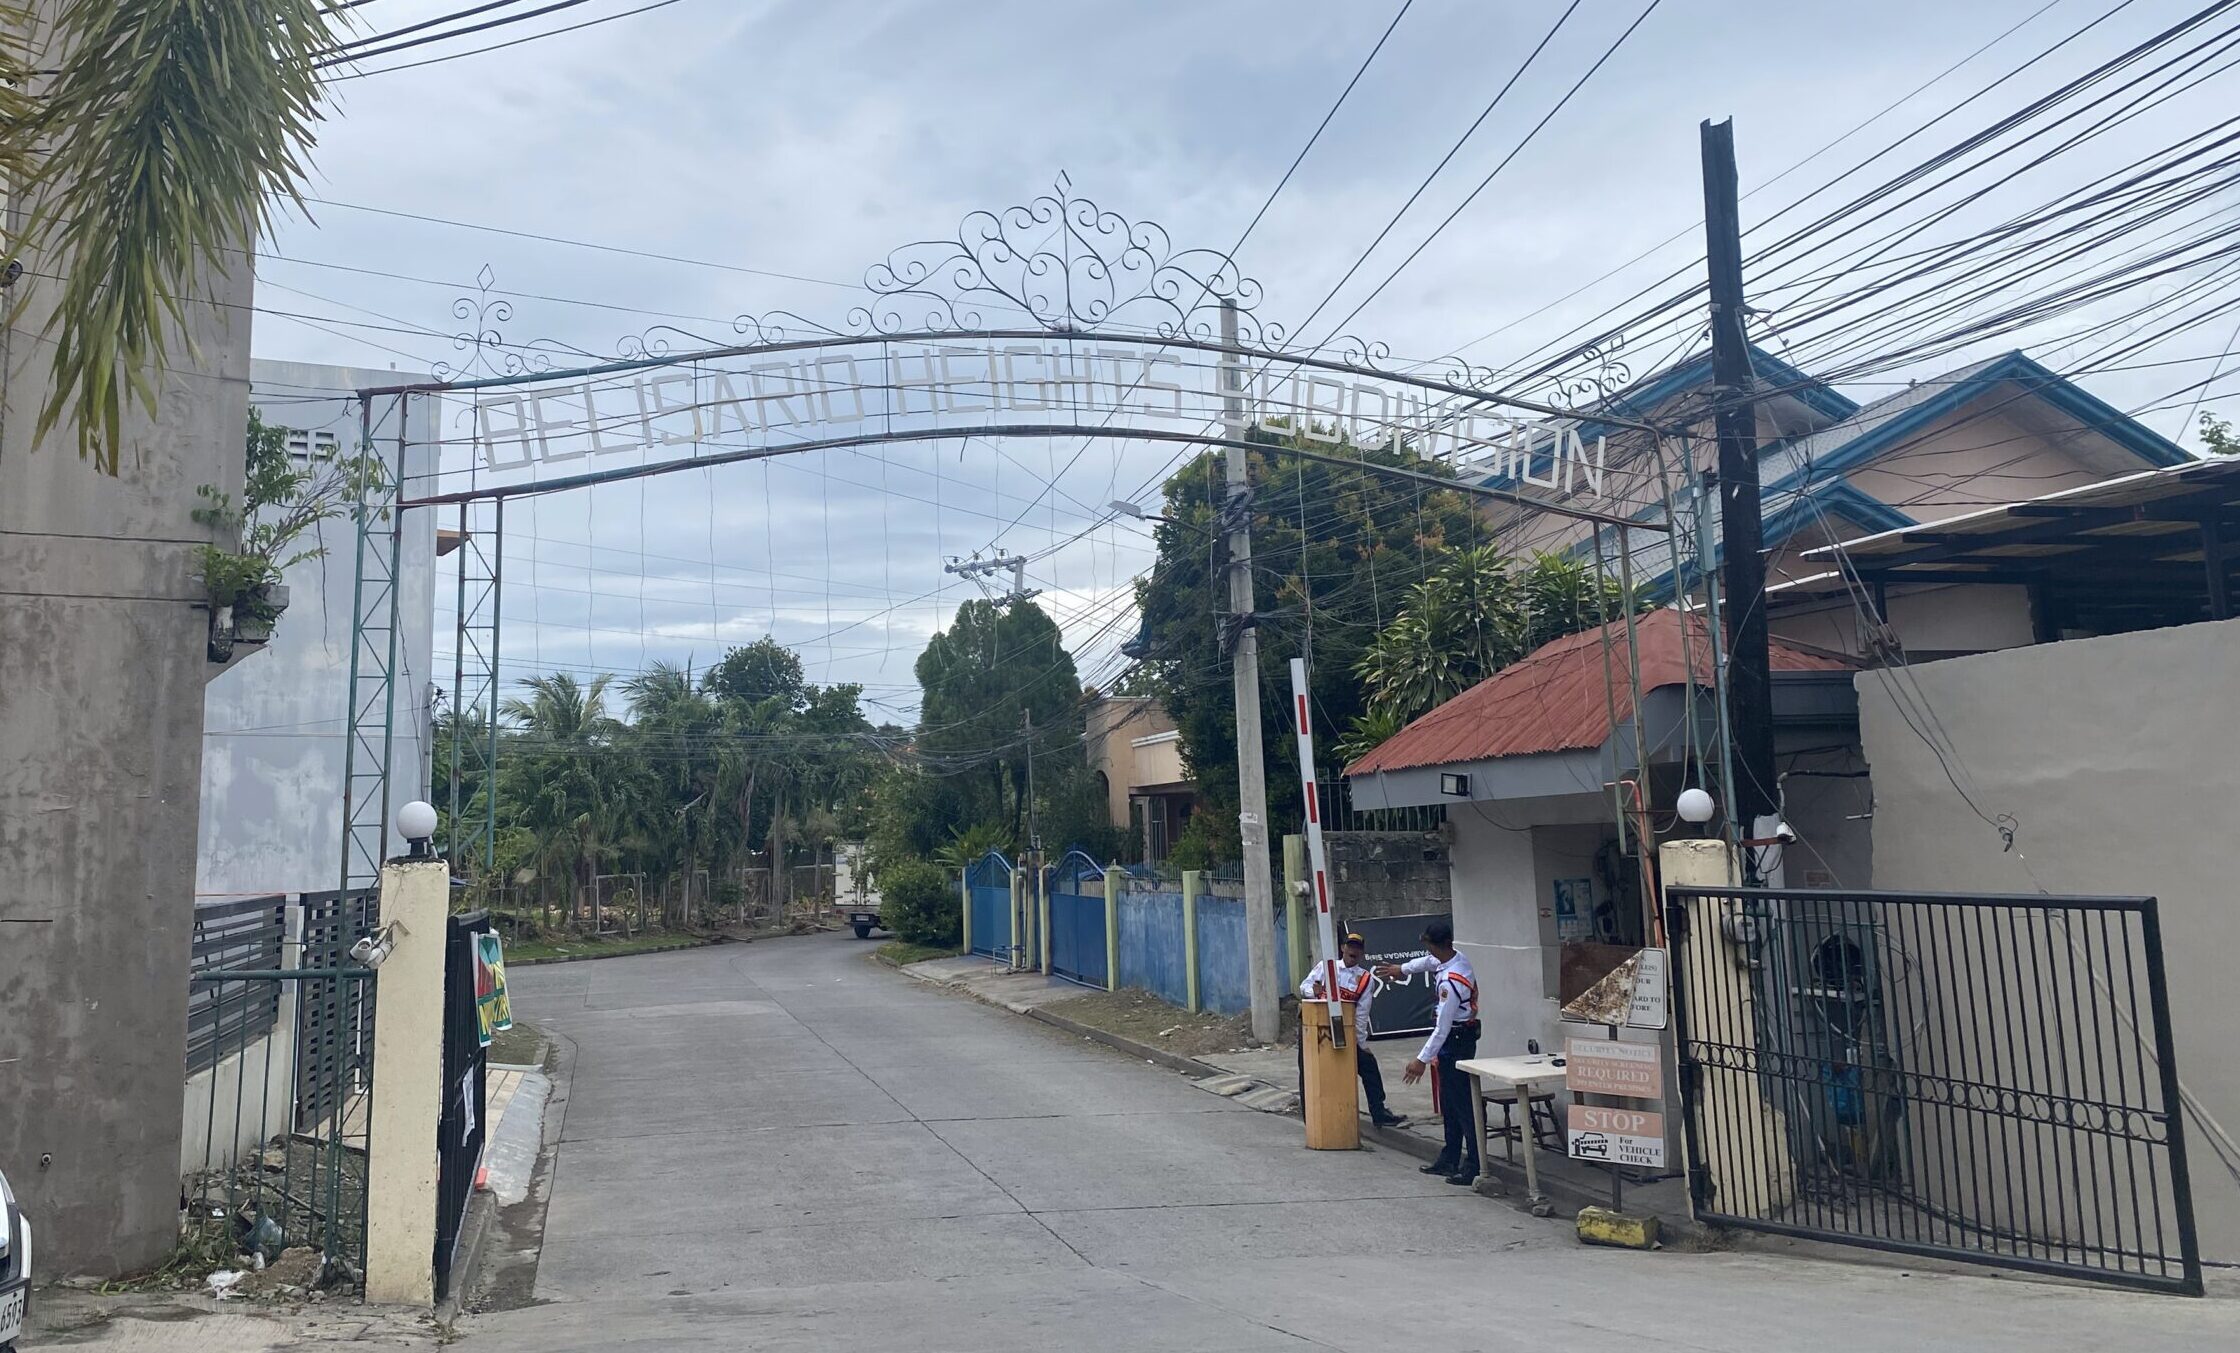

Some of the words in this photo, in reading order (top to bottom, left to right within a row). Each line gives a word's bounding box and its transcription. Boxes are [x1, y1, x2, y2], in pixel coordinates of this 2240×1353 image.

[478, 353, 866, 472] BELISARIO
[891, 345, 1183, 419] HEIGHTS
[1214, 360, 1607, 500] SUBDIVISION
[1577, 1066, 1650, 1083] REQUIRED
[1584, 1110, 1646, 1132] STOP
[1619, 1136, 1633, 1145] For
[1619, 1144, 1662, 1157] VEHICLE
[1619, 1154, 1653, 1165] CHECK
